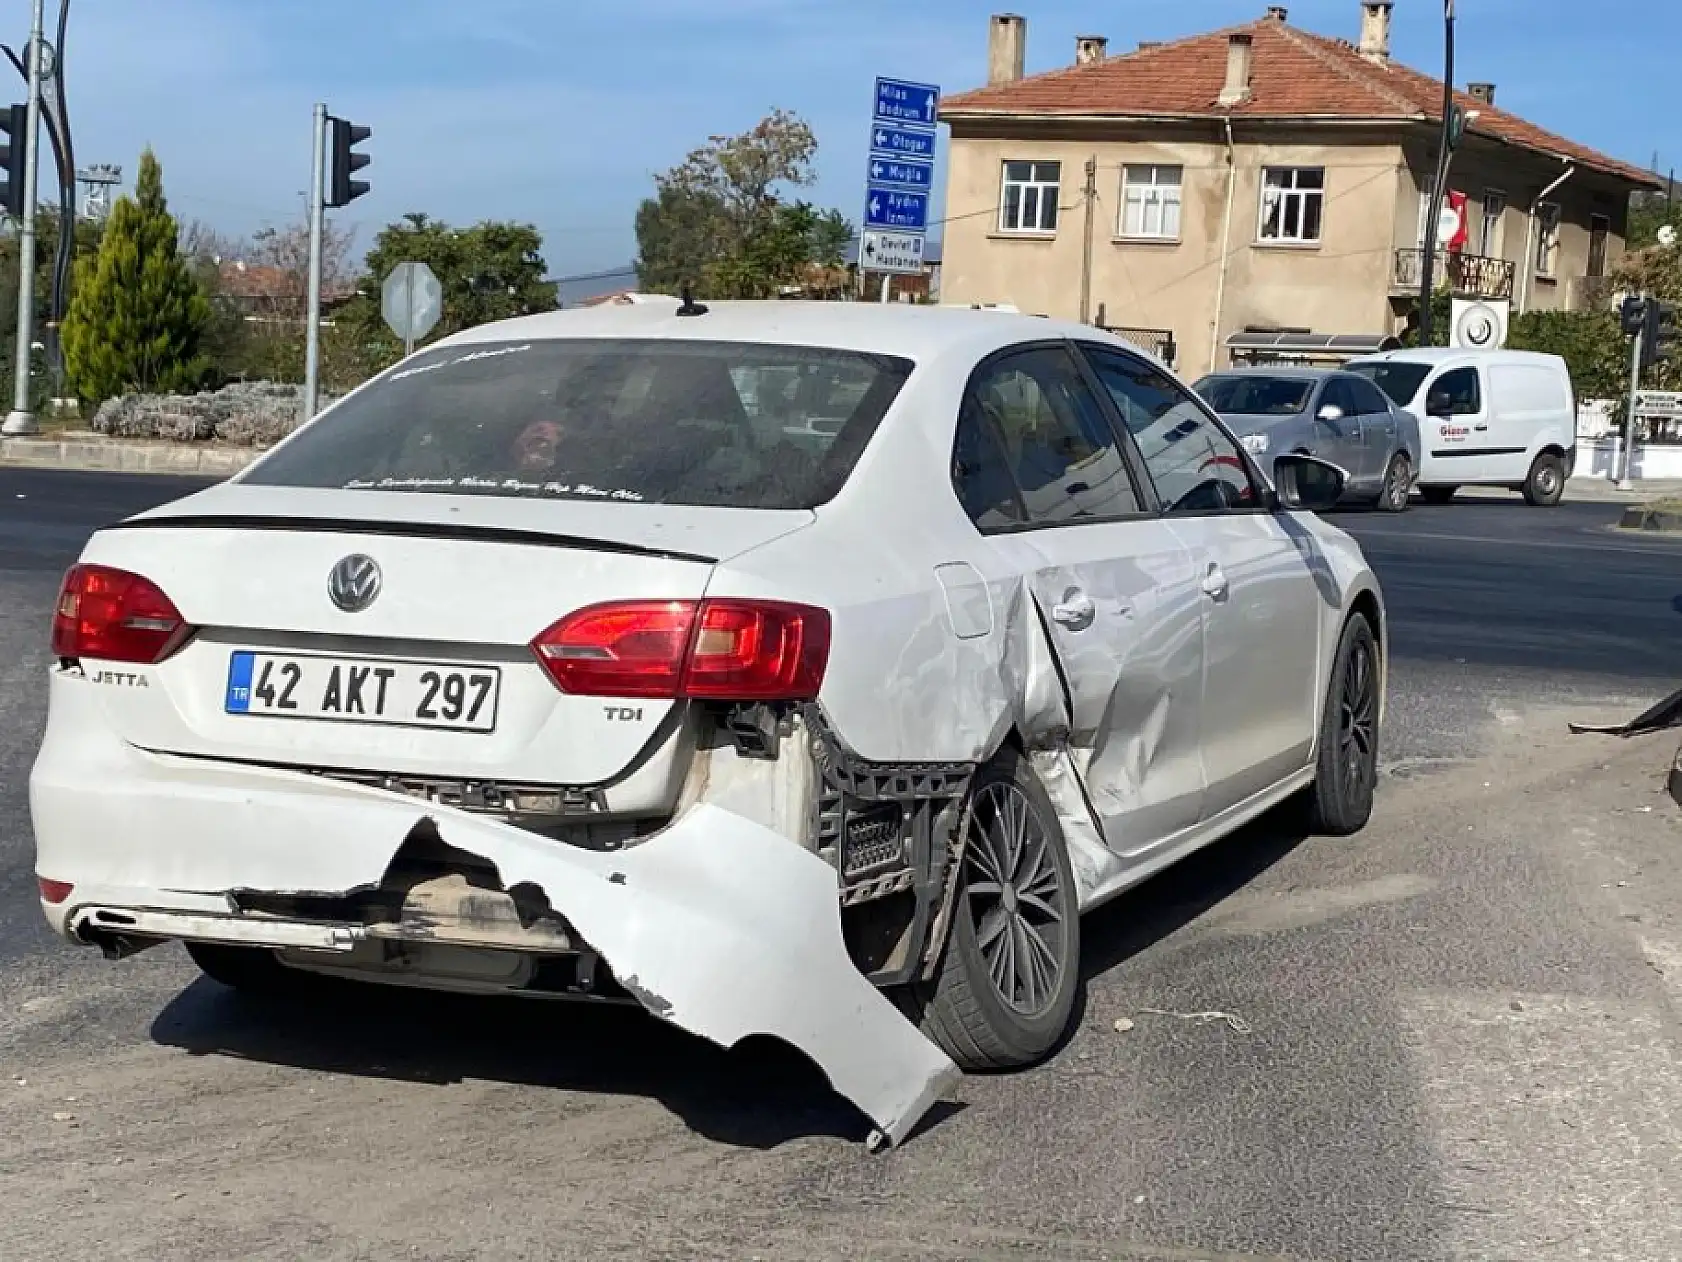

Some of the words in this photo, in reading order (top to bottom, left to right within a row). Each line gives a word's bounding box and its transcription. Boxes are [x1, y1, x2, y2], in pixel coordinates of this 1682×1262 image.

[92, 671, 149, 687] JETTA
[232, 687, 248, 699] TR
[256, 660, 302, 709] 42
[321, 665, 395, 714] AKT
[416, 671, 493, 722] 297
[603, 706, 643, 721] TDI
